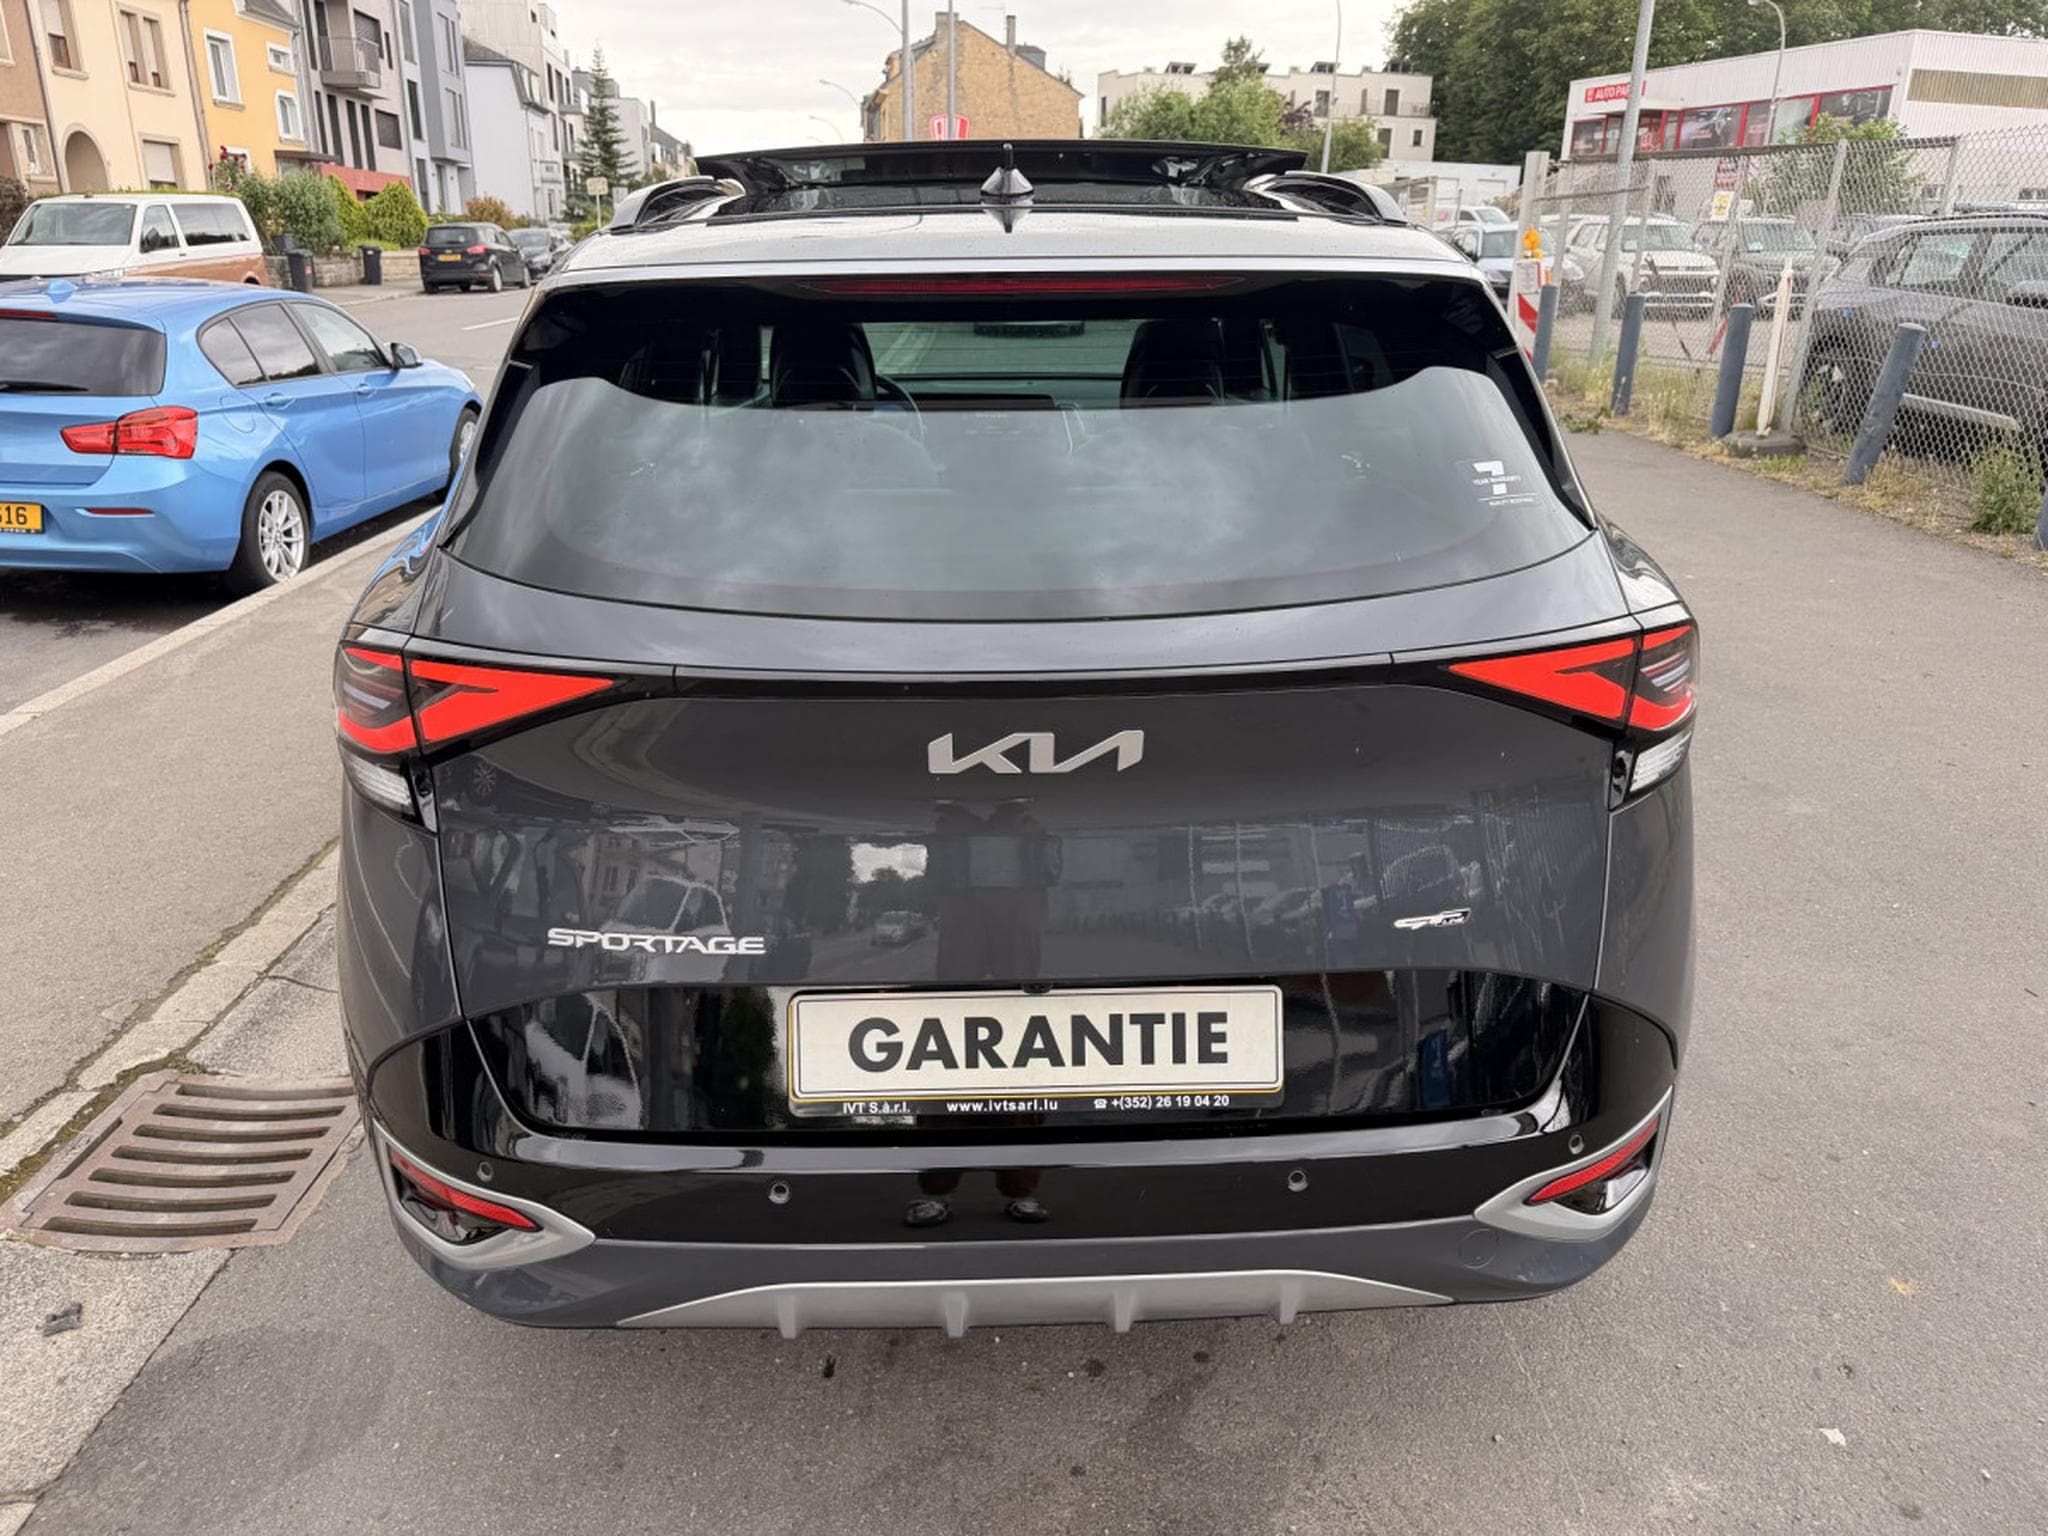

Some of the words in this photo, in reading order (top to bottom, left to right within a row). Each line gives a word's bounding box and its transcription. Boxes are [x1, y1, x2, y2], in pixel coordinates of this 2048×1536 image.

[1595, 87, 1616, 100] AUTO
[0, 505, 28, 526] 16
[928, 730, 1144, 774] KIA
[548, 928, 766, 955] SPORTAGE
[848, 1011, 1229, 1073] GARANTIE
[843, 1102, 865, 1114] IVT
[946, 1099, 1059, 1112] www.ivtsarl.lu
[1112, 1096, 1152, 1110] +(352)
[1156, 1096, 1172, 1108] 26
[1176, 1096, 1191, 1107] 19
[1194, 1095, 1210, 1107] 04
[1213, 1094, 1230, 1107] 20
